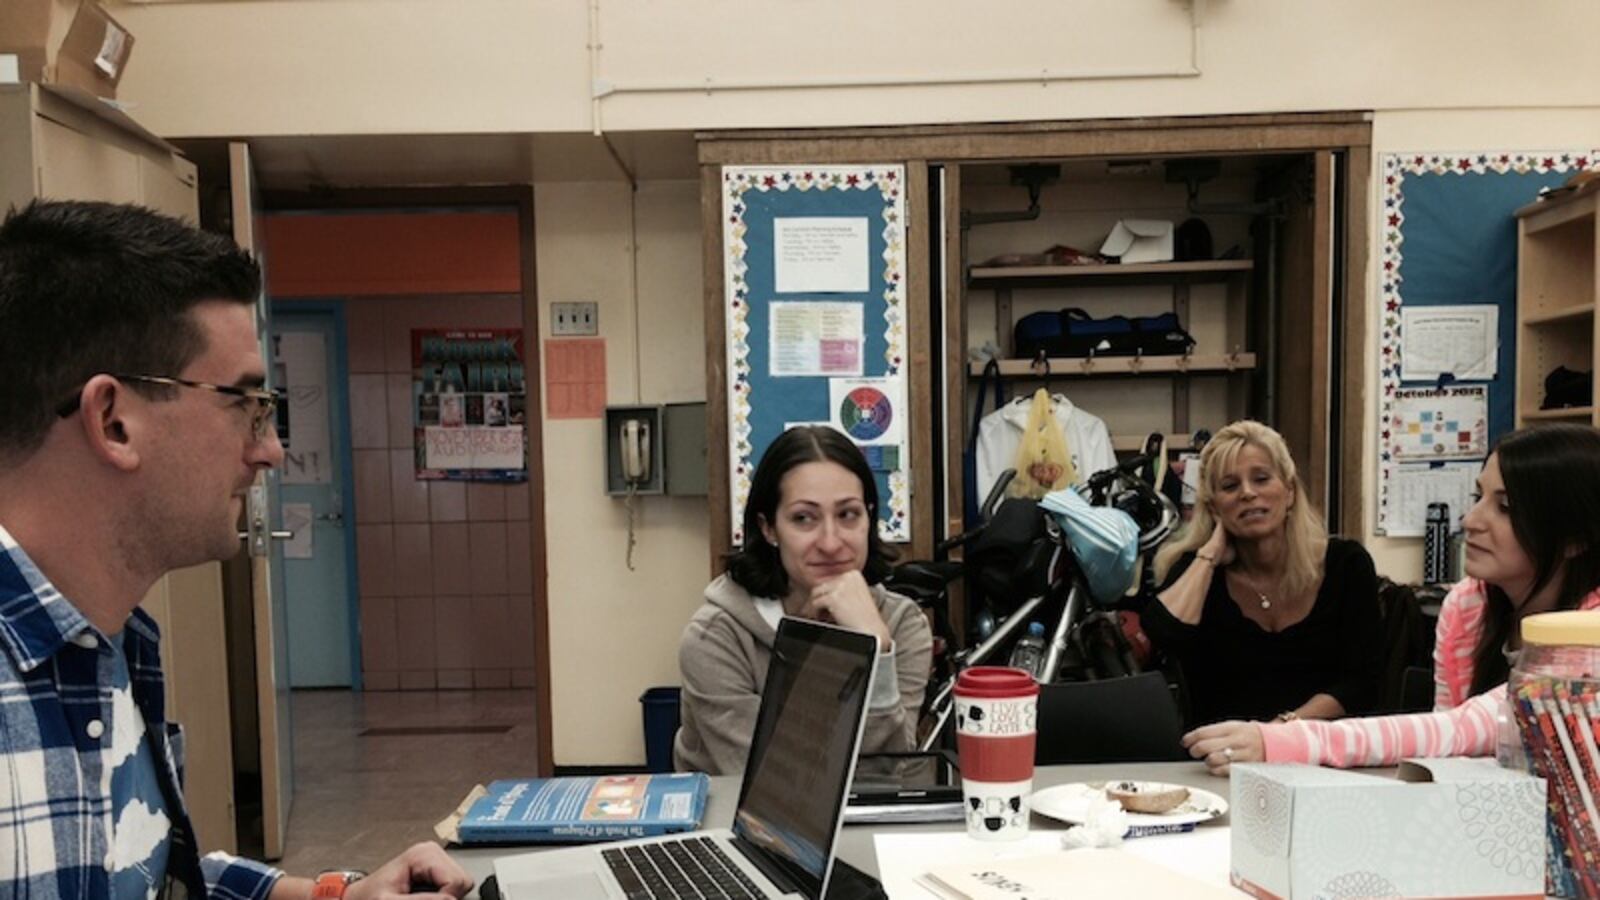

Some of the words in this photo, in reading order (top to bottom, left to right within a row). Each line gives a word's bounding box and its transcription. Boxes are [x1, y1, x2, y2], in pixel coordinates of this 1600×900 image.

[1394, 388, 1449, 399] October
[427, 431, 497, 446] NOVEMBER
[991, 702, 1021, 713] LIVE
[991, 713, 1021, 723] LOVE
[989, 722, 1021, 734] LATTE
